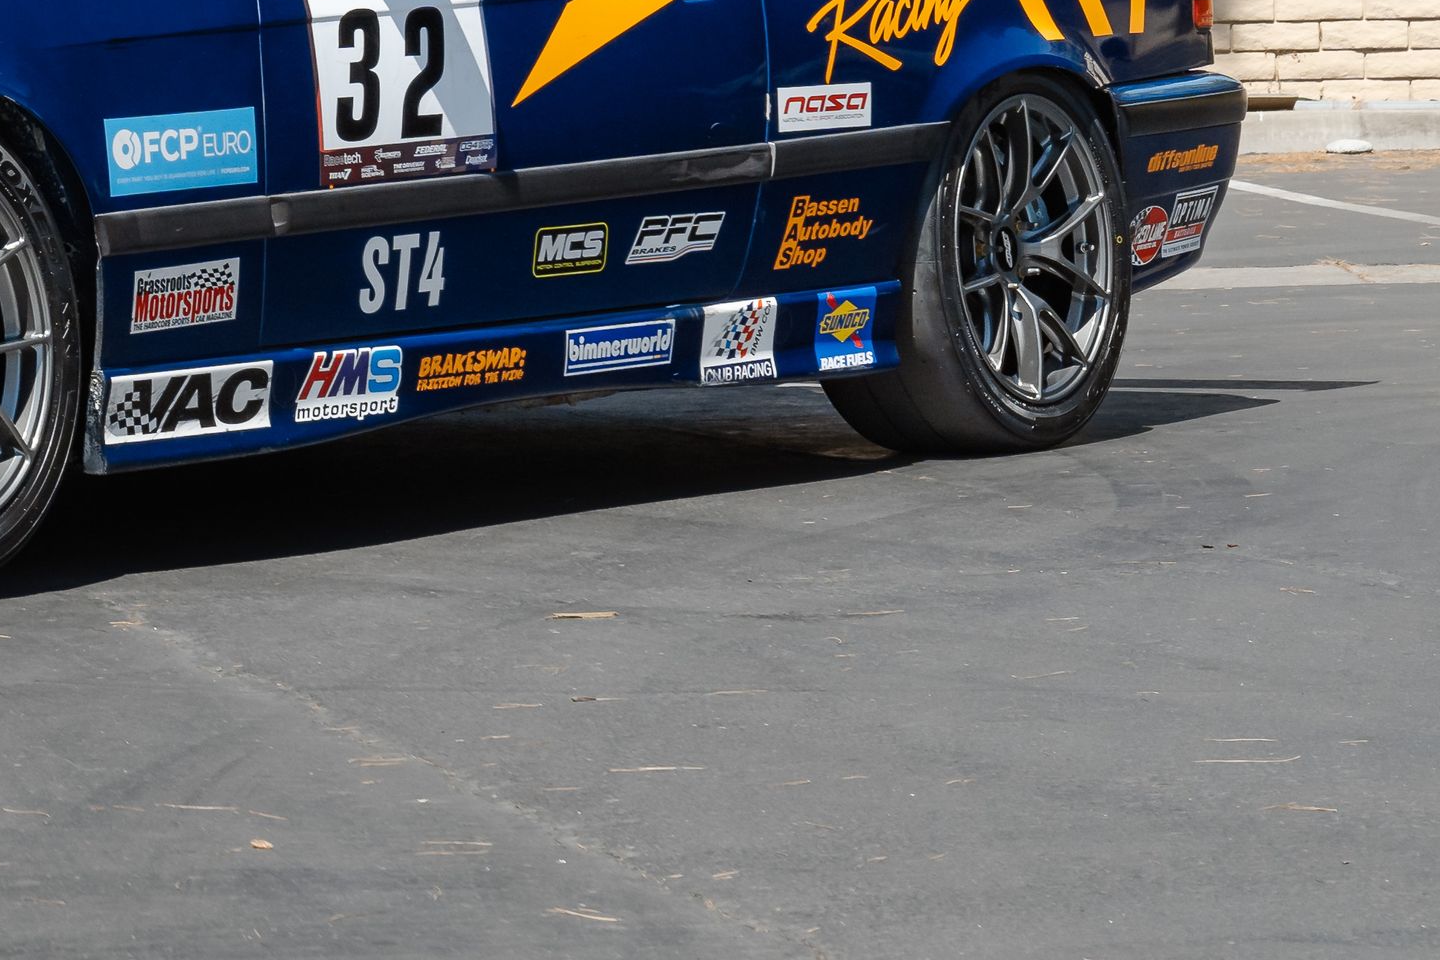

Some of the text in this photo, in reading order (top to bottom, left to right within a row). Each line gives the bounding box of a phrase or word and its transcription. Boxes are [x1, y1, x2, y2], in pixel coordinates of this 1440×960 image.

[336, 5, 445, 142] 32
[783, 92, 868, 114] nasa
[143, 128, 252, 164] FCP EURO
[791, 196, 860, 219] Bassen
[1172, 197, 1212, 225] OPTIMA
[634, 213, 725, 247] PFC
[783, 215, 873, 243] Autobody
[538, 230, 605, 262] MCS
[631, 245, 677, 256] BRAKES
[777, 245, 827, 267] Shop
[137, 273, 193, 296] Grassroots
[358, 230, 445, 314] ST4
[134, 283, 236, 324] Motorsports
[821, 311, 868, 332] SUNOCO
[568, 328, 672, 362] bimmerworld
[298, 346, 402, 401] HMS
[734, 360, 773, 380] RACING
[819, 351, 874, 371] RACE FUELS
[416, 375, 463, 392] FRICTION
[464, 373, 481, 386] FOR
[485, 371, 499, 384] THE
[122, 368, 269, 436] VAC
[296, 396, 397, 421] motorsport
